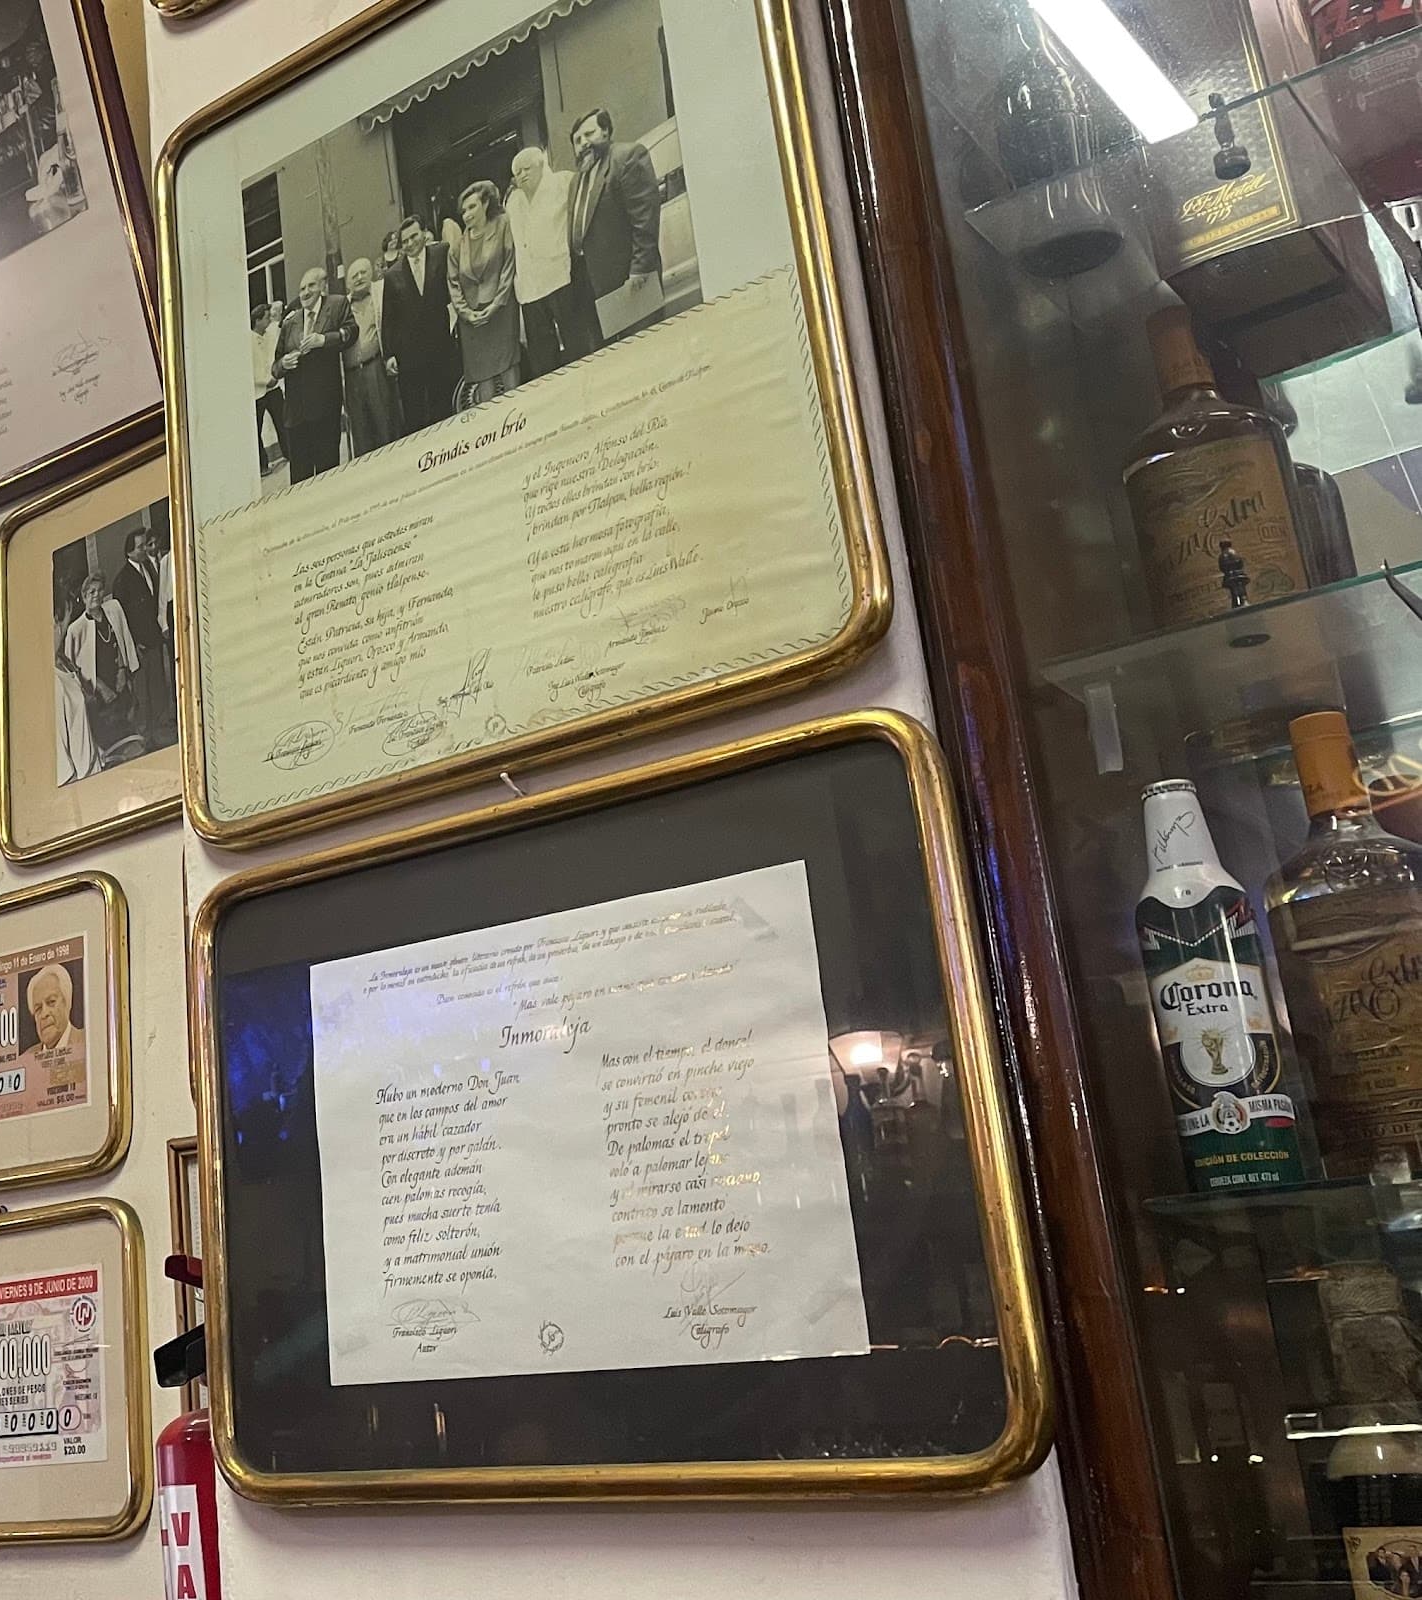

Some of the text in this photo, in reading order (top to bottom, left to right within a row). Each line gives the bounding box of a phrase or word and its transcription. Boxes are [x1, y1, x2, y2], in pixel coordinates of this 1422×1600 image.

[418, 441, 470, 472] Brindis
[474, 432, 497, 450] con
[500, 408, 527, 440] brío
[29, 953, 46, 964] Enero
[1160, 979, 1254, 1012] Corona
[1187, 1002, 1228, 1016] Extra
[623, 1054, 639, 1065] con
[643, 1045, 653, 1061] el
[14, 1073, 20, 1090] 0
[602, 1058, 754, 1091] se convirtió en pinche viejo
[376, 1071, 520, 1104] Hubo un moderno Don Juan
[379, 1096, 508, 1132] que en los campos del amor
[615, 1087, 678, 1116] su femenil
[1249, 1100, 1272, 1113] MISMA
[397, 1132, 408, 1143] un
[412, 1124, 436, 1141] hábil
[442, 1120, 482, 1137] cazador
[606, 1119, 642, 1142] pronto
[646, 1118, 658, 1128] se
[381, 1136, 501, 1171] por discreto y por galán.
[608, 1134, 690, 1162] De palomas el
[1226, 1154, 1240, 1164] DE
[1240, 1150, 1290, 1163] COLECCIÓN
[382, 1159, 482, 1189] Con elegante ademán
[643, 1156, 692, 1183] palomar
[382, 1195, 400, 1205] cien
[402, 1187, 444, 1212] palomas
[383, 1198, 501, 1232] pues mucha suerte tenía
[383, 1235, 405, 1246] como
[407, 1228, 433, 1251] feliz
[383, 1242, 502, 1274] y a matrimonial unión
[0, 1275, 93, 1300] VIERNES 9 DE JUNIO DE 2000
[383, 1272, 444, 1298] firmemente
[446, 1272, 456, 1282] se
[17, 1385, 26, 1394] DE
[11, 1414, 18, 1432] 0
[28, 1412, 35, 1430] 0
[46, 1411, 53, 1429] 0
[64, 1408, 72, 1427] 0
[64, 1445, 86, 1455] $20.00
[171, 1511, 191, 1546] V
[177, 1564, 197, 1600] A
